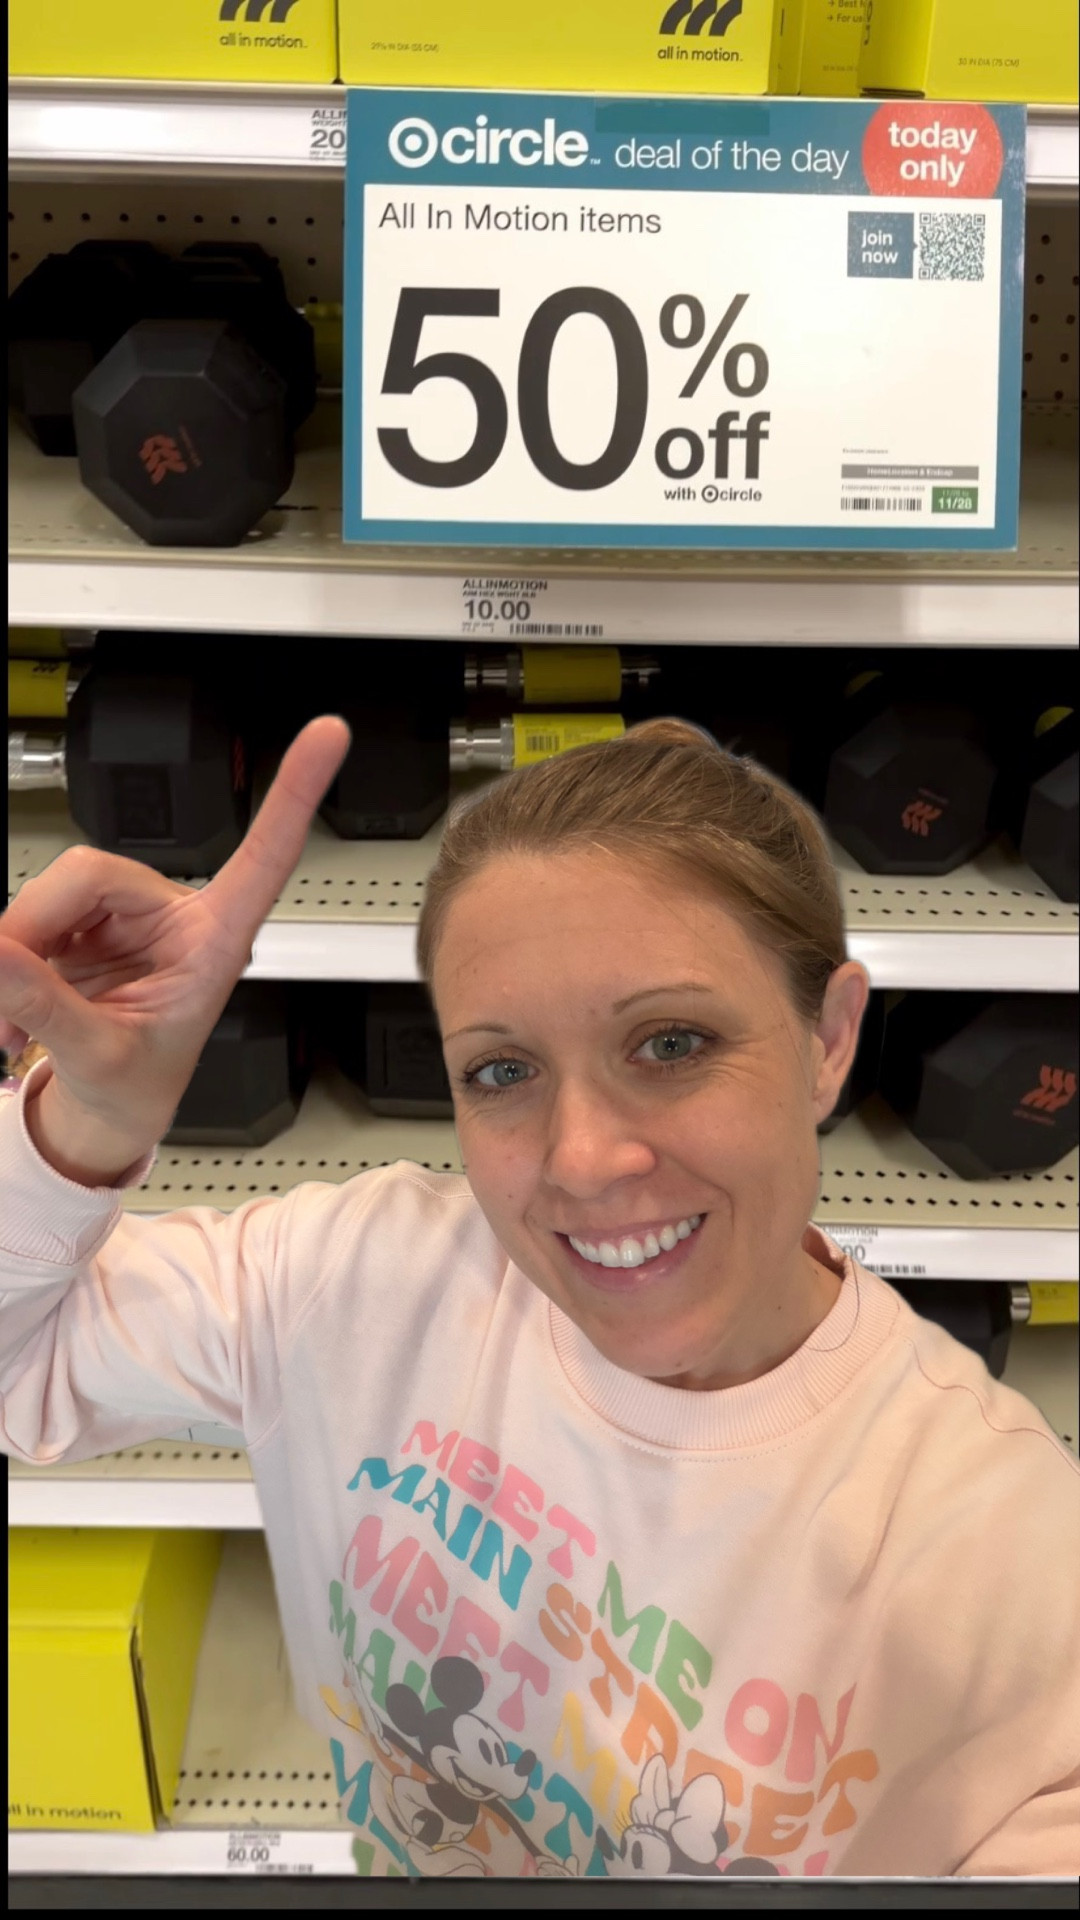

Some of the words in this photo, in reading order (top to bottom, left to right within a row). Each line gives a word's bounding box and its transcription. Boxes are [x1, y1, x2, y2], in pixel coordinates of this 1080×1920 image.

[220, 33, 236, 46] all
[239, 33, 251, 46] in
[658, 46, 674, 59] all
[676, 46, 688, 60] in
[889, 121, 977, 155] today
[615, 138, 681, 169] deal
[691, 140, 722, 170] of
[731, 141, 782, 172] the
[791, 142, 849, 180] day
[900, 155, 965, 187] only
[379, 202, 415, 229] All
[428, 203, 453, 230] In
[465, 204, 569, 232] Motion
[580, 206, 662, 234] items
[862, 229, 893, 248] join
[862, 251, 898, 264] now
[655, 410, 770, 480] off
[664, 486, 697, 501] with
[938, 497, 973, 510] 11/28
[463, 579, 548, 591] ALLINMOTION
[464, 599, 531, 621] 10.00
[347, 1456, 533, 1612] MAIN
[401, 1420, 597, 1580] MEET
[597, 1560, 714, 1732] ME
[724, 1677, 858, 1784] ON
[342, 1514, 550, 1733] MEET
[49, 1806, 122, 1820] motion
